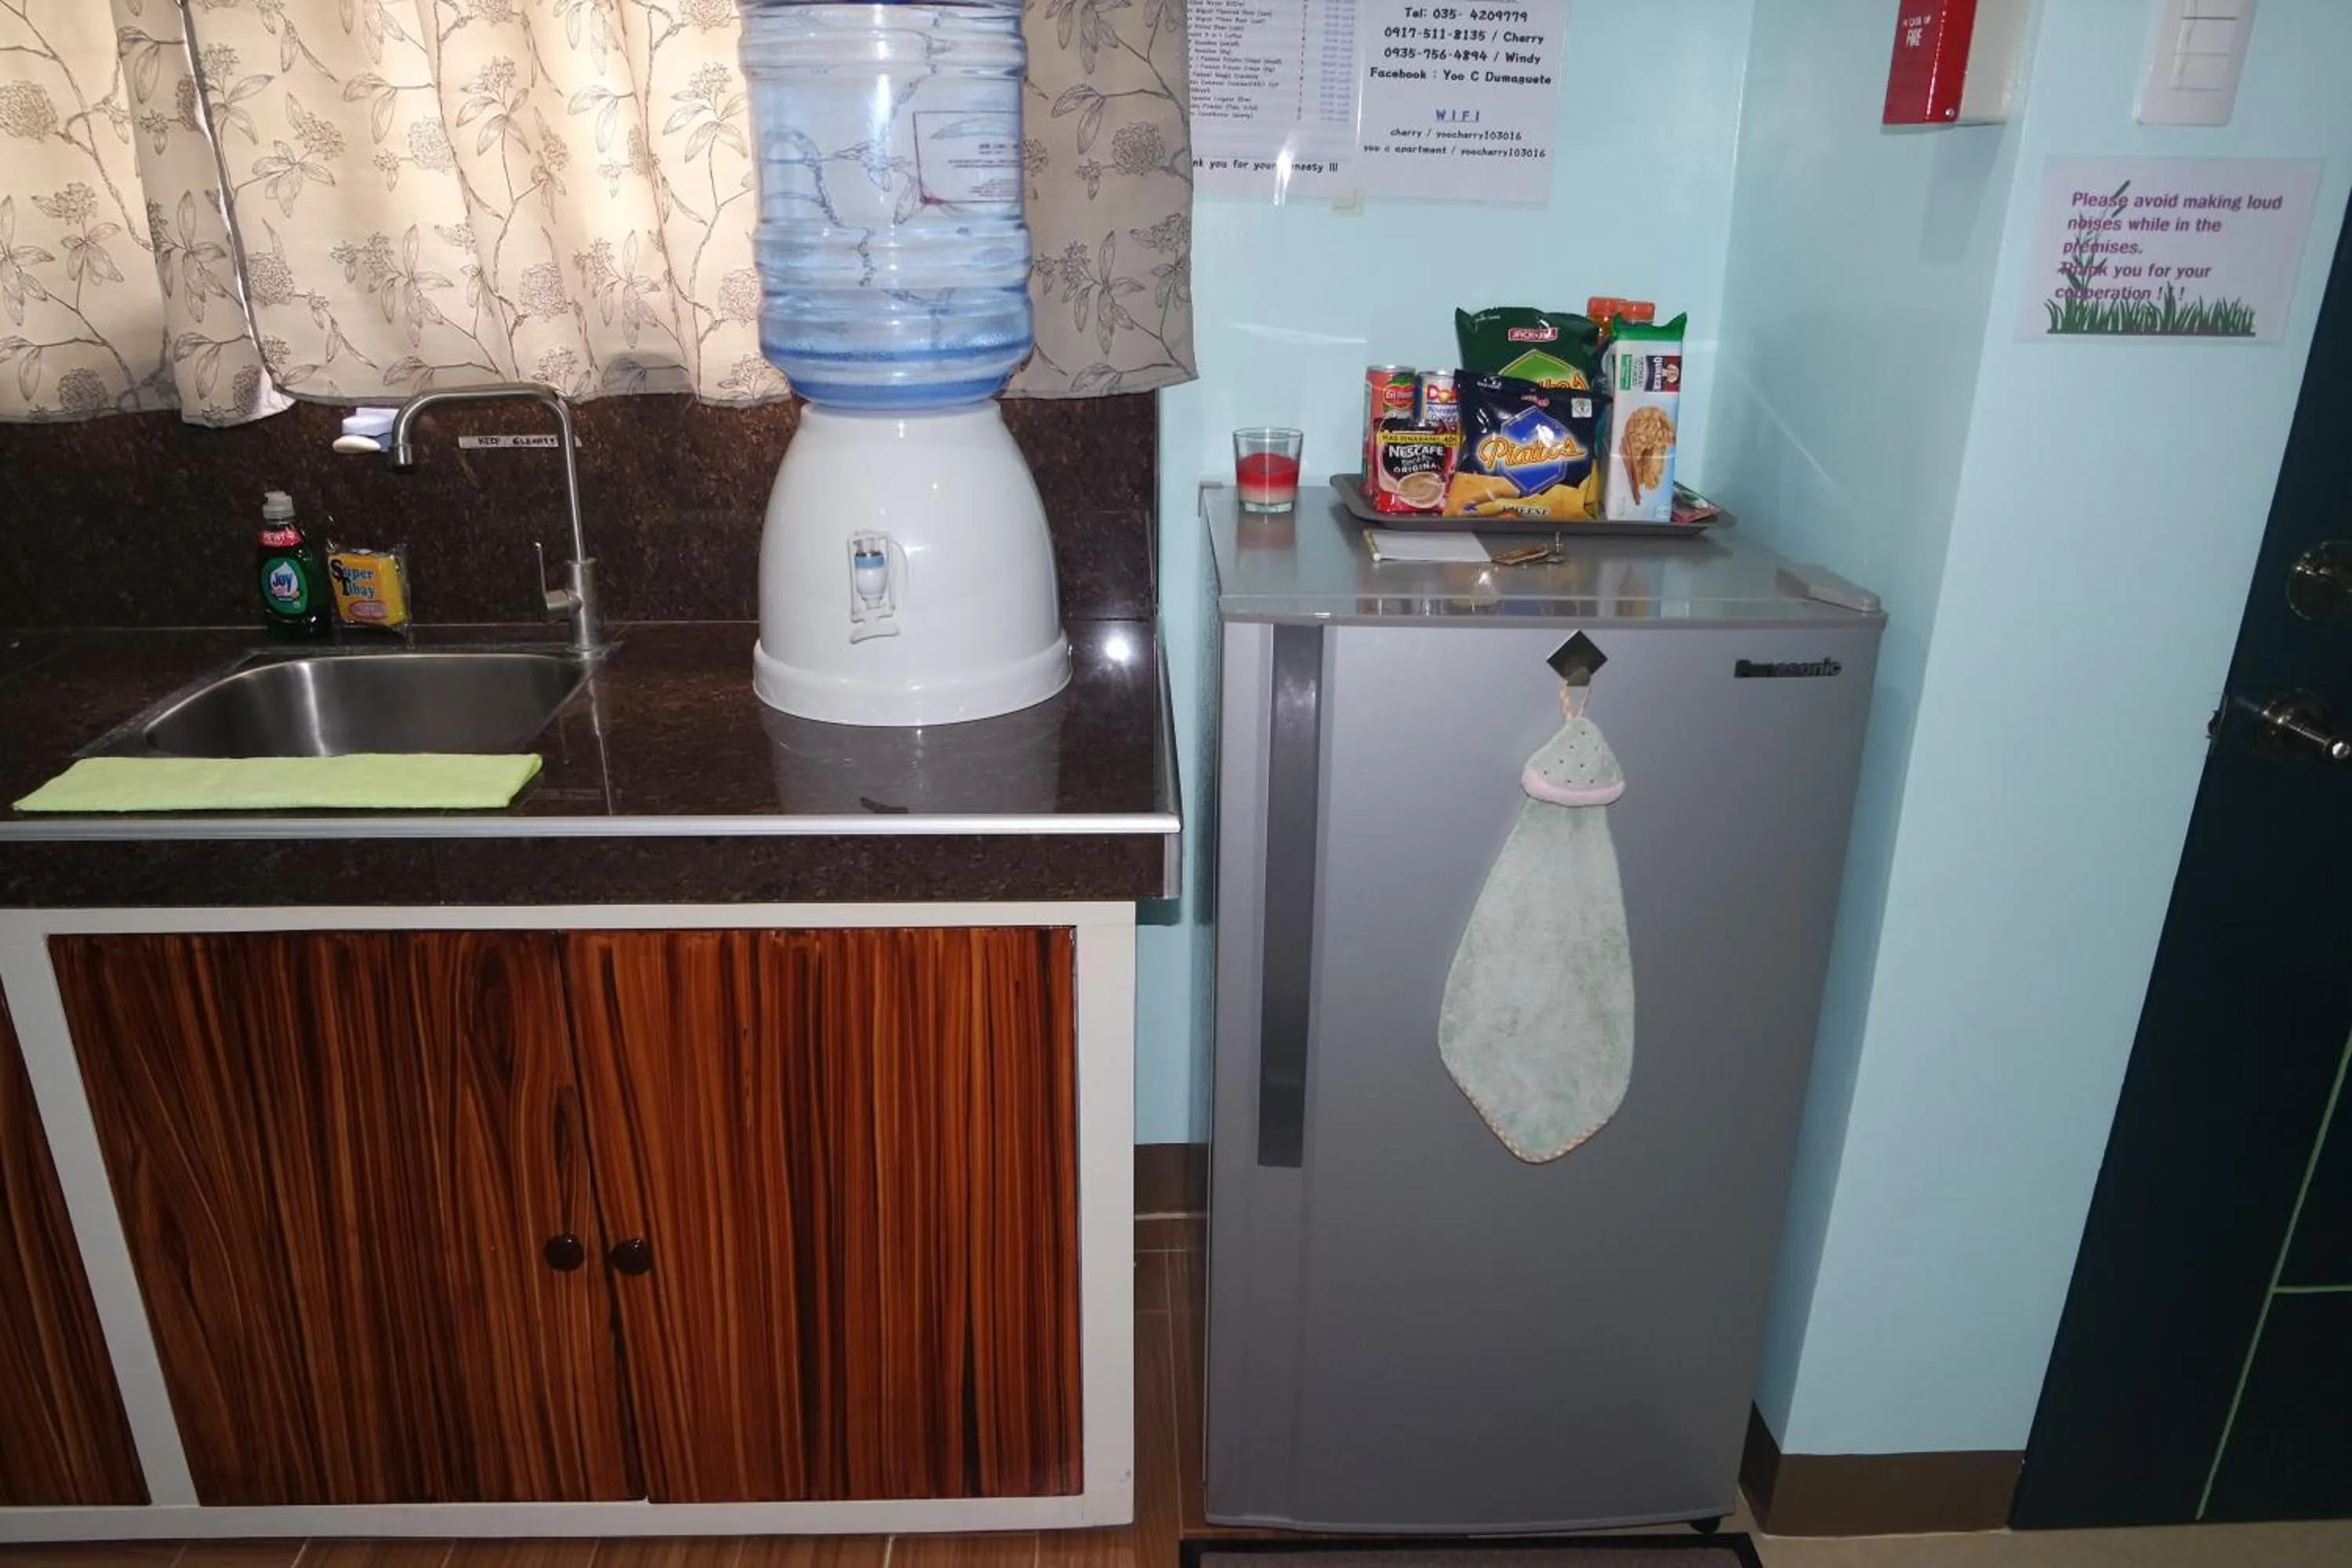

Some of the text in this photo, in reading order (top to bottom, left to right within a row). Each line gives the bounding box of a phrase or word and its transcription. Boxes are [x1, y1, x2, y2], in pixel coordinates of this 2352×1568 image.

[1405, 7, 1427, 18] Tel:
[1470, 9, 1528, 22] 4209779
[1384, 27, 1486, 40] 0917-511-8135
[1504, 31, 1544, 45] Cherry
[1384, 47, 1487, 61] 0935-756-4894
[1505, 52, 1541, 64] Windy
[1370, 67, 1426, 79] Facebook
[1471, 71, 1479, 82] C
[1486, 72, 1552, 85] Dumaguete
[1390, 129, 1421, 138] cherry
[1395, 145, 1446, 154] apartment
[1210, 161, 1227, 171] you
[1233, 160, 1248, 169] for
[2072, 192, 2283, 212] Please avoid making loud
[2067, 218, 2222, 233] noises while in the
[2063, 241, 2143, 255] premises.
[2060, 262, 2212, 279] Thank you for your
[2055, 285, 2151, 303] cooperation
[330, 559, 373, 582] Super
